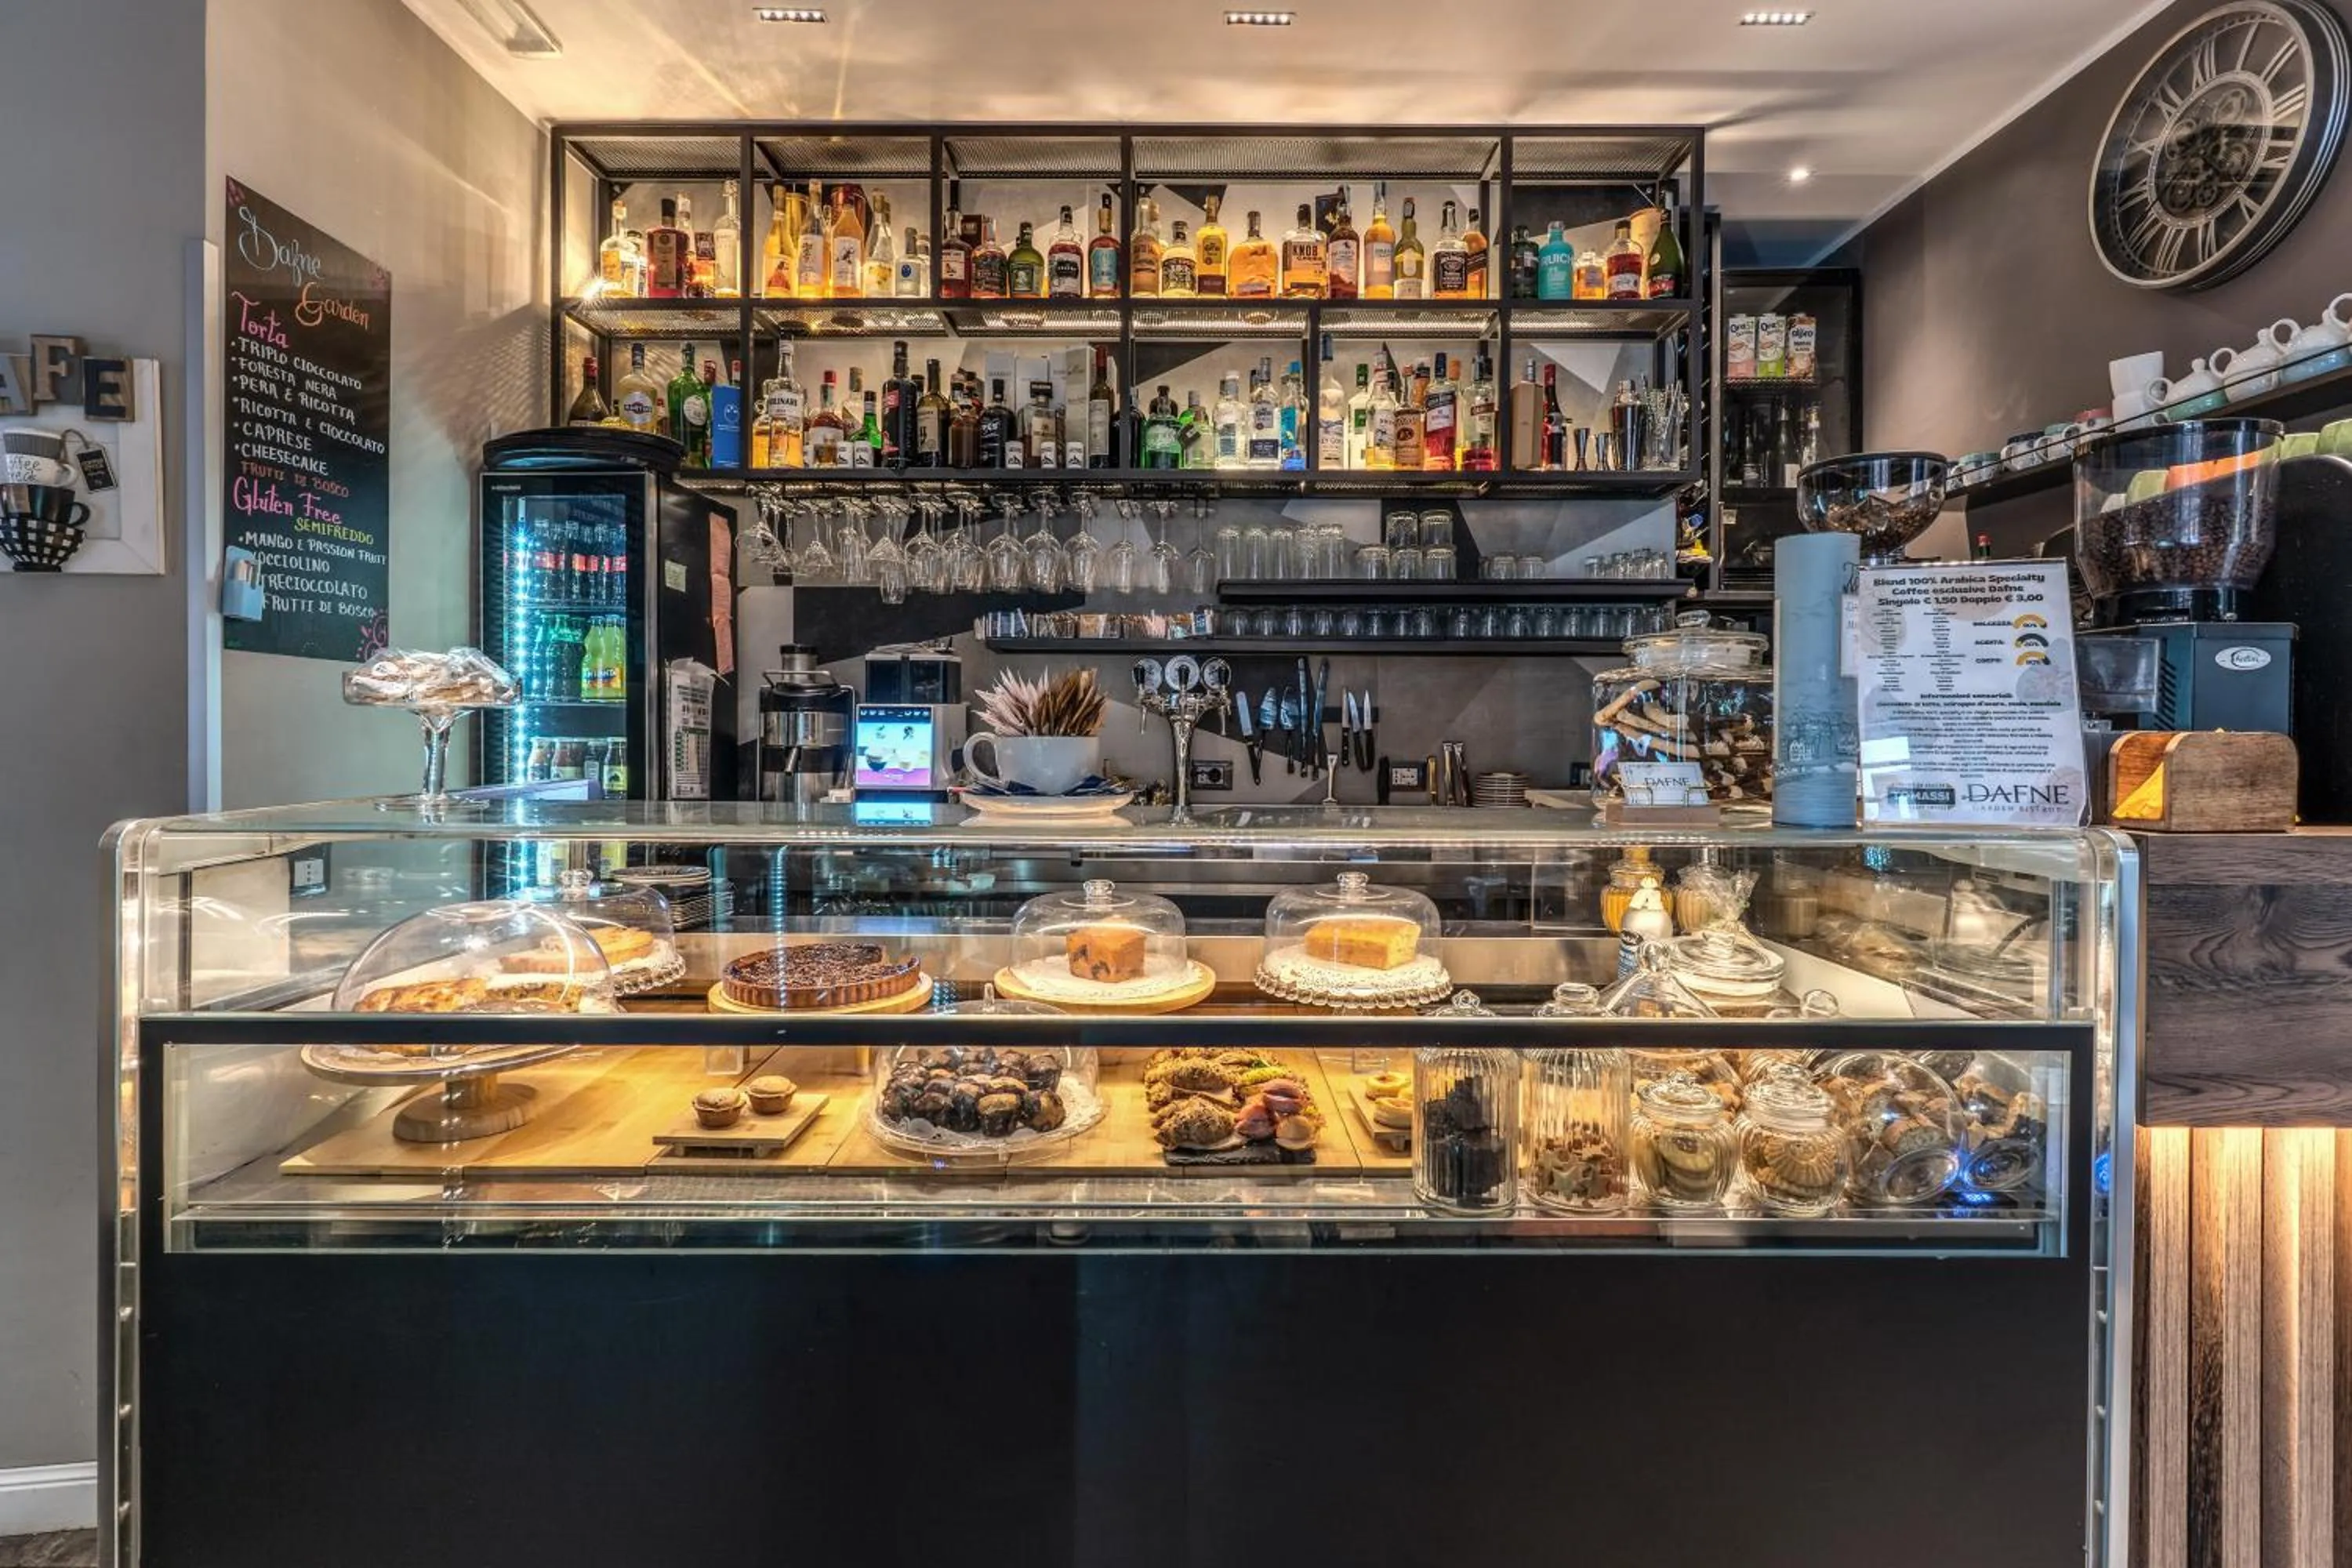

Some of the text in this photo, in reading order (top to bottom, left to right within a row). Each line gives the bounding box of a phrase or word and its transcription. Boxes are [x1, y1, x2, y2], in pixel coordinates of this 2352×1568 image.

[1293, 245, 1318, 256] KNOB
[231, 291, 289, 348] Torta
[295, 281, 369, 330] Garden
[238, 336, 362, 390] TRIPLO CIOCCOLATO
[238, 357, 338, 400] FORESTA NERA
[239, 374, 278, 400] PERA
[298, 392, 355, 426] RICOTTA
[240, 397, 297, 426] RICOTTA
[319, 421, 385, 455] CIOCCOLATO
[242, 421, 313, 452] CAPRESE
[241, 442, 329, 476] CHEESECAKE
[234, 475, 343, 525] Gluten Free
[245, 531, 295, 550] MANGO
[307, 539, 356, 560] PASSION
[293, 516, 374, 546] SEMIFREDDO
[1892, 587, 1929, 596] Coffee
[1988, 584, 2024, 593] Dafne
[1908, 577, 1936, 586] 100%
[1940, 575, 1985, 585] Arabica
[1988, 574, 2045, 585] Specialty
[262, 593, 376, 618] FRUTTI DI BOSCO
[1878, 598, 1920, 608] Singolo
[1960, 595, 2002, 605] Doppio
[1967, 783, 2070, 804] DAFNE
